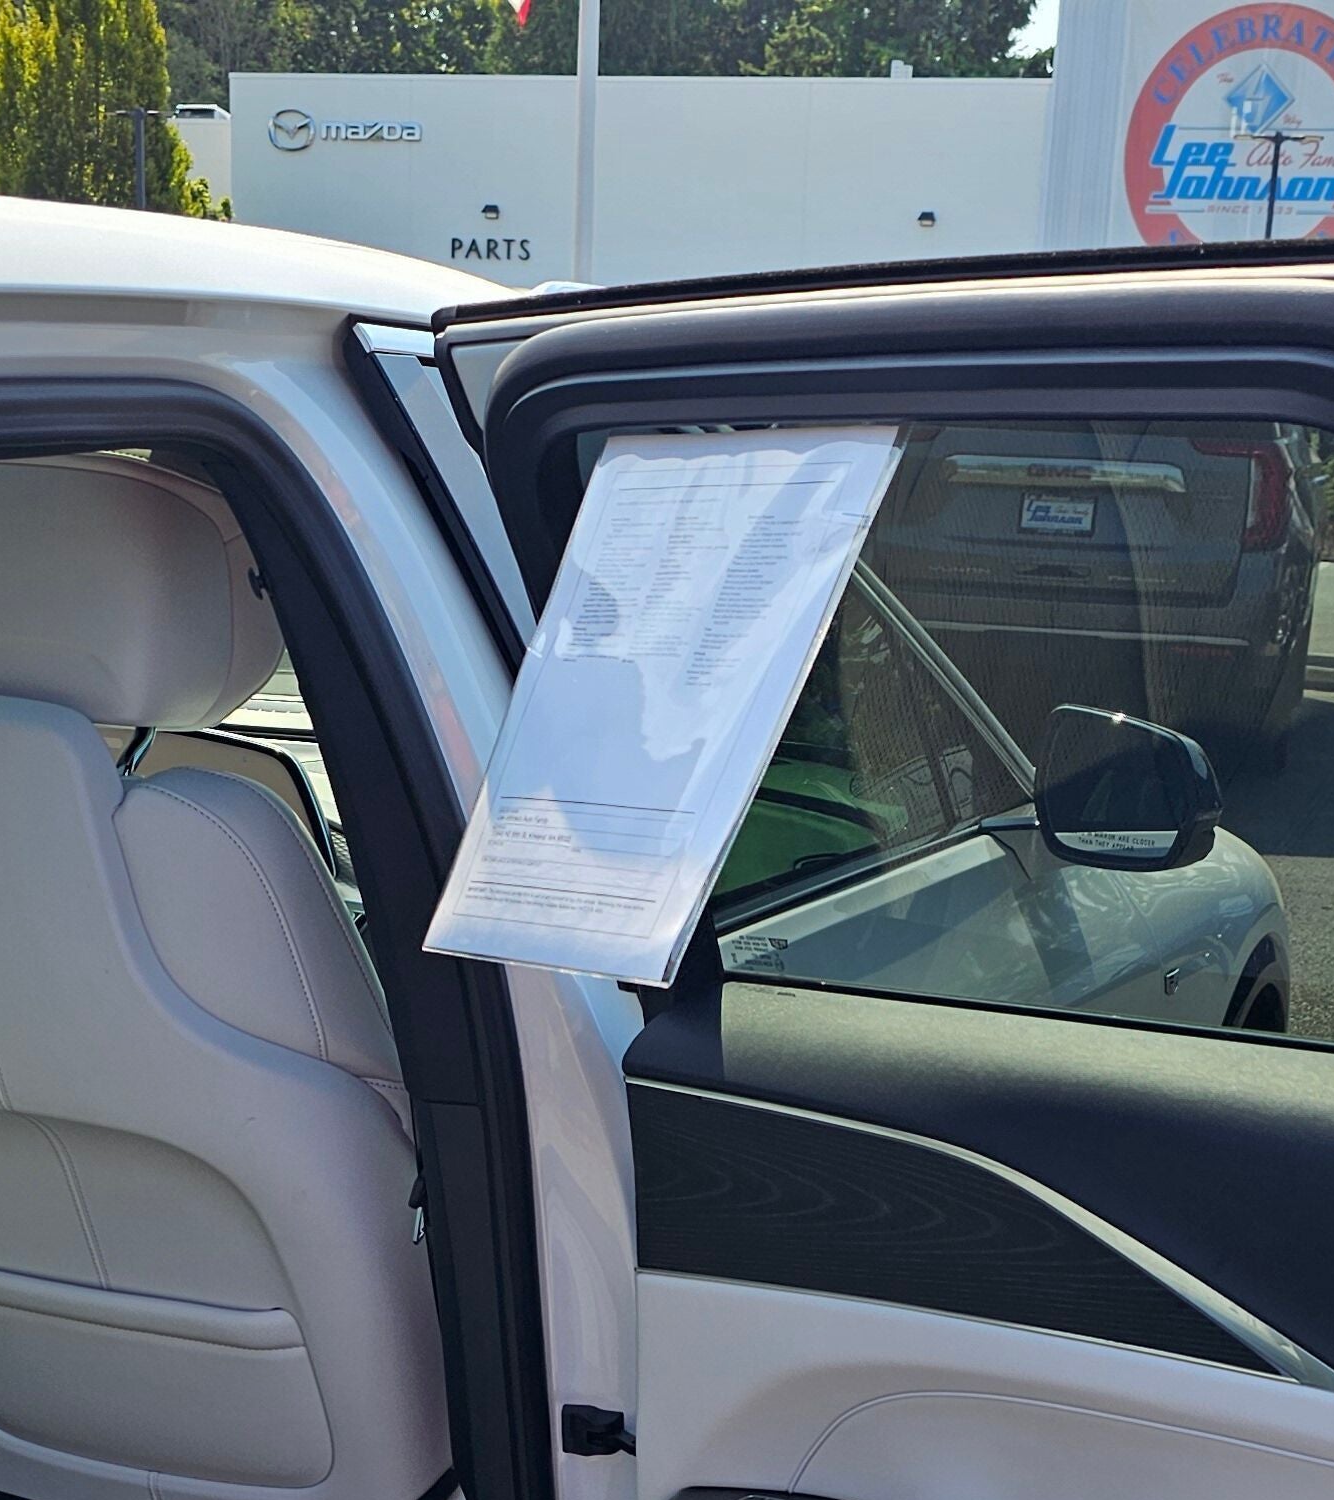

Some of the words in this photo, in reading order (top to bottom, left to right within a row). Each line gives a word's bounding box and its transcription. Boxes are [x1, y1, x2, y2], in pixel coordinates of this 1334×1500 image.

[1283, 114, 1302, 126] Way
[320, 121, 423, 142] mazda
[1151, 124, 1236, 166] Lee
[1206, 205, 1250, 214] SINCE
[1258, 205, 1294, 215] 133
[451, 237, 531, 261] PARTS
[1027, 463, 1095, 478] GMC
[1133, 837, 1155, 847] CLOSER
